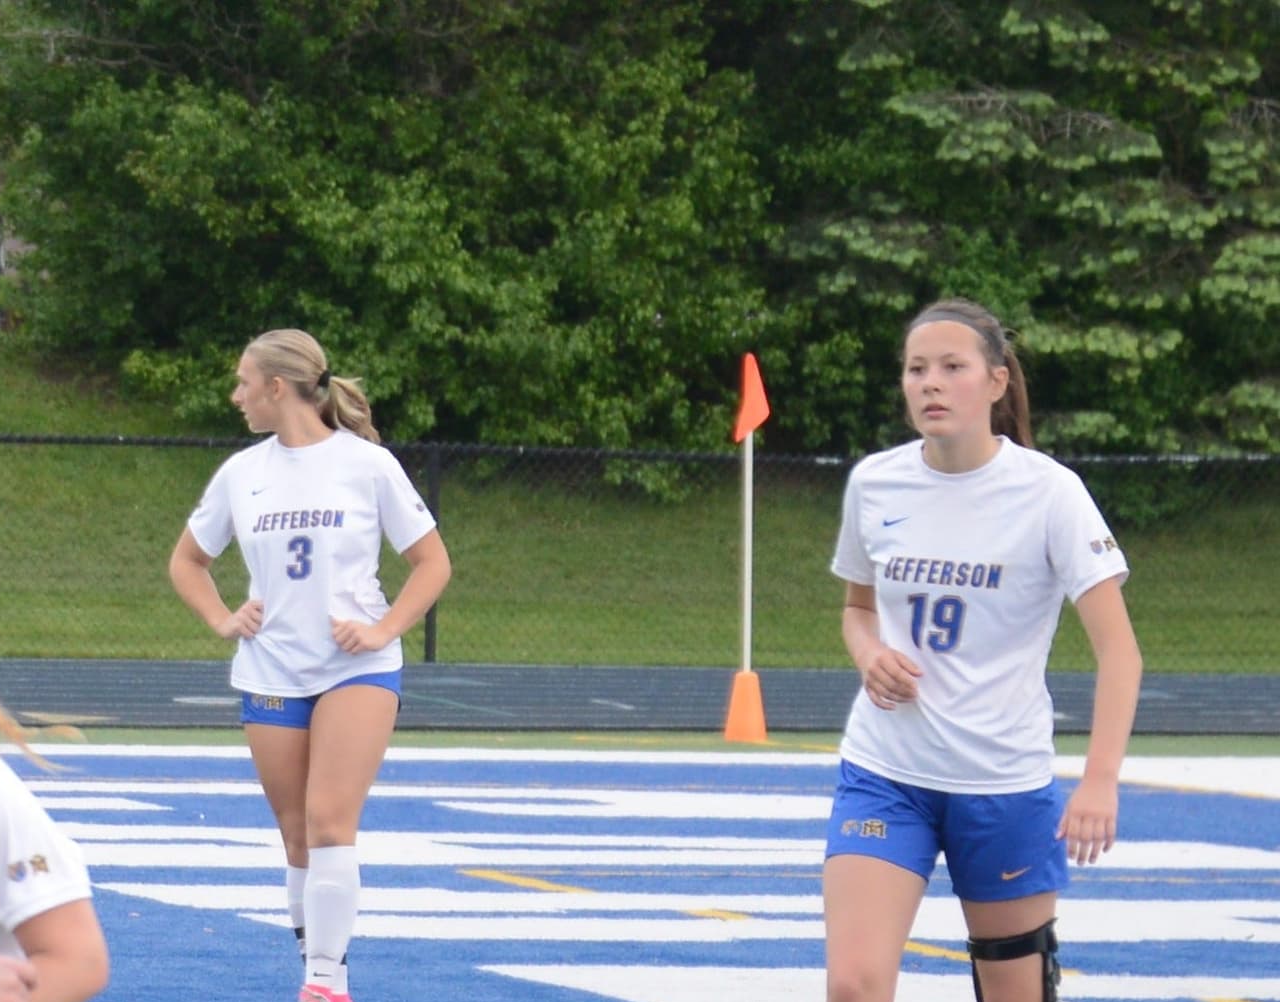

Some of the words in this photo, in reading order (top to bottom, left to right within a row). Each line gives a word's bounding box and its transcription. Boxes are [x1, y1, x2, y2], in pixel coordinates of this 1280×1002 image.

[252, 509, 345, 533] JEFFERSON
[286, 535, 313, 581] 3
[884, 556, 1003, 590] JEFFERSON
[906, 592, 967, 655] 19
